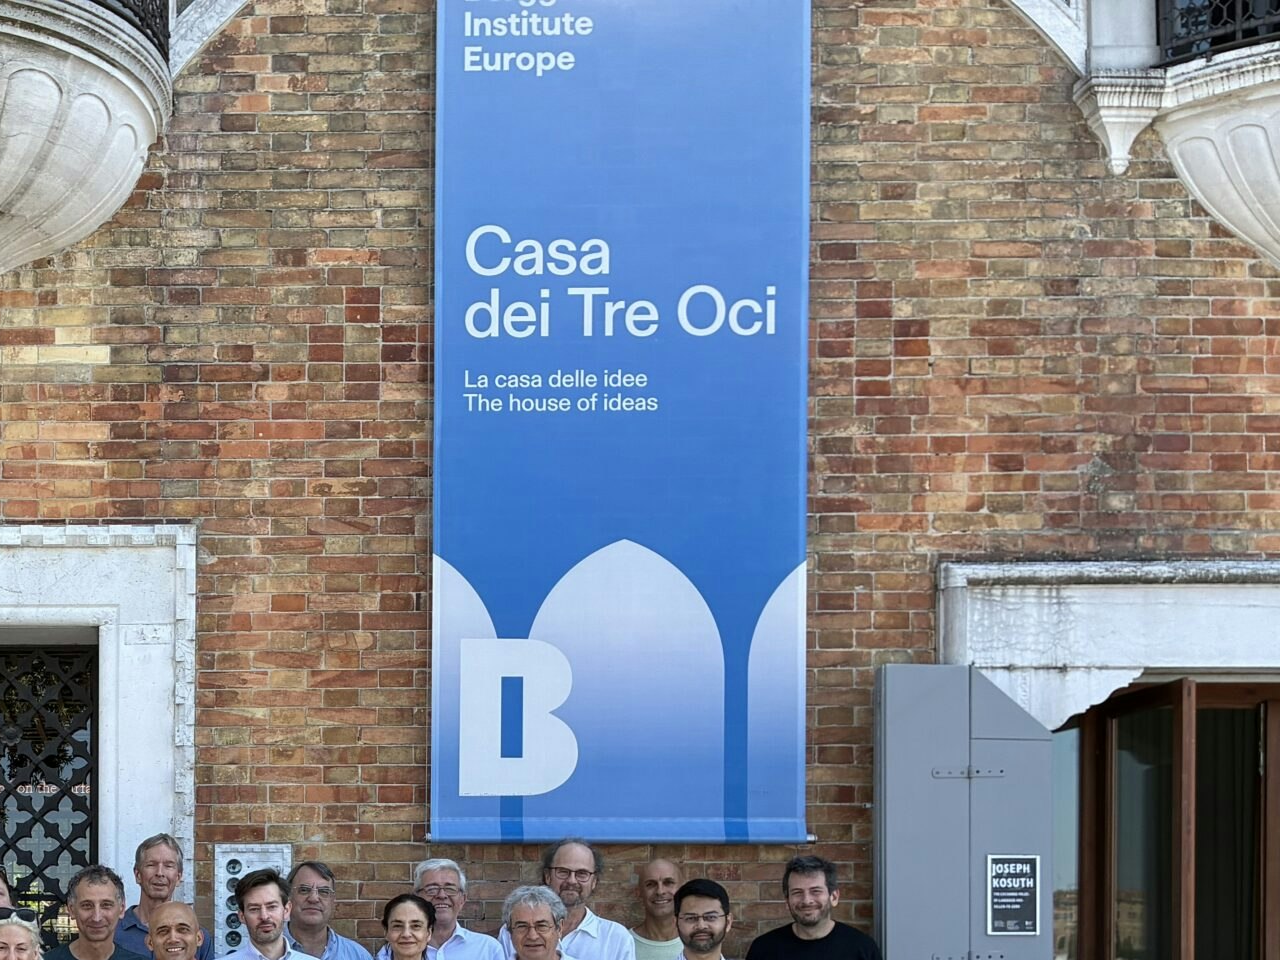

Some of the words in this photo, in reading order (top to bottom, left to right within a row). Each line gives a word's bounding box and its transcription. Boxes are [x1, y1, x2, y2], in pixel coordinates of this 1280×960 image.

[465, 11, 593, 36] Institute
[465, 46, 575, 76] Europe
[466, 225, 610, 276] Casa
[465, 288, 550, 338] dei
[568, 286, 659, 337] Tre
[678, 285, 776, 336] Oci
[465, 371, 489, 388] La
[495, 373, 542, 388] casa
[548, 370, 598, 387] delle
[604, 370, 648, 387] idee
[465, 394, 503, 411] The
[509, 394, 571, 411] house
[577, 393, 598, 411] of
[603, 393, 658, 411] ideas
[459, 639, 579, 796] B
[992, 864, 1030, 876] JOSEPH
[993, 878, 1033, 888] KOSUTH
